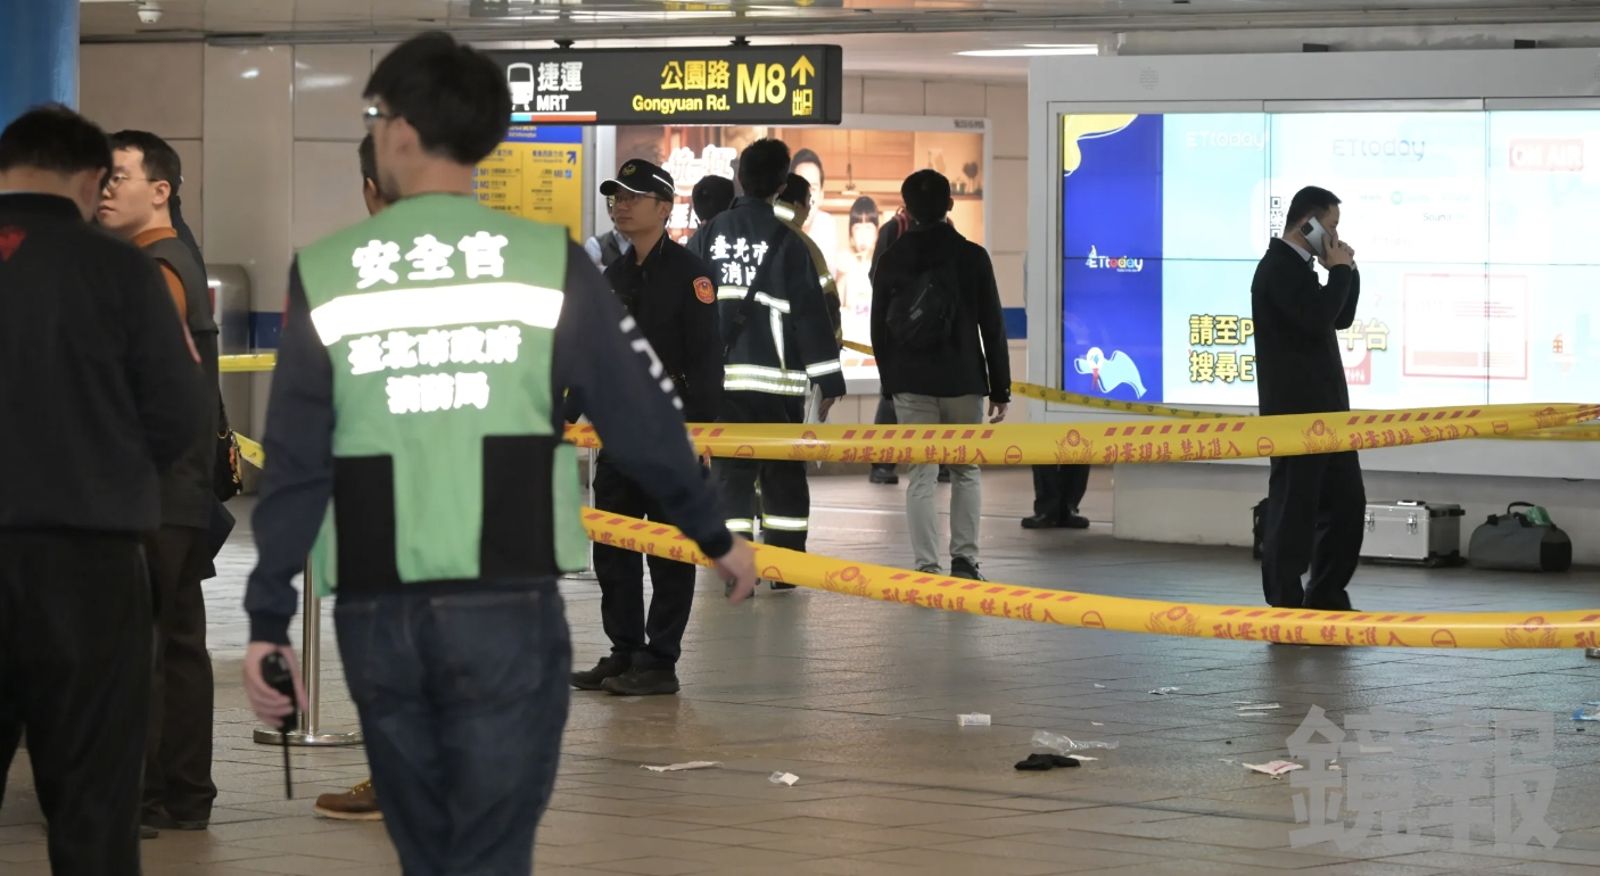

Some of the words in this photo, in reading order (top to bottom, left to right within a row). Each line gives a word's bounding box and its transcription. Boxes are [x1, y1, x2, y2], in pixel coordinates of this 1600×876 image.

[537, 61, 583, 91] 捷運
[661, 60, 730, 90] 公園路
[736, 63, 786, 104] M8
[536, 94, 569, 111] MRT
[632, 95, 702, 114] Gongyuan
[706, 95, 730, 111] Rd.
[1333, 138, 1426, 161] ETtoday
[352, 231, 509, 289] 安全官
[709, 235, 769, 266] 臺北市
[1089, 256, 1144, 272] ETtoday
[1189, 314, 1254, 346] 請至P
[1335, 317, 1390, 351] 平台
[1189, 350, 1256, 383] 搜尋E
[1103, 441, 1173, 465] 刑案現場
[1180, 438, 1242, 461] 禁止進入
